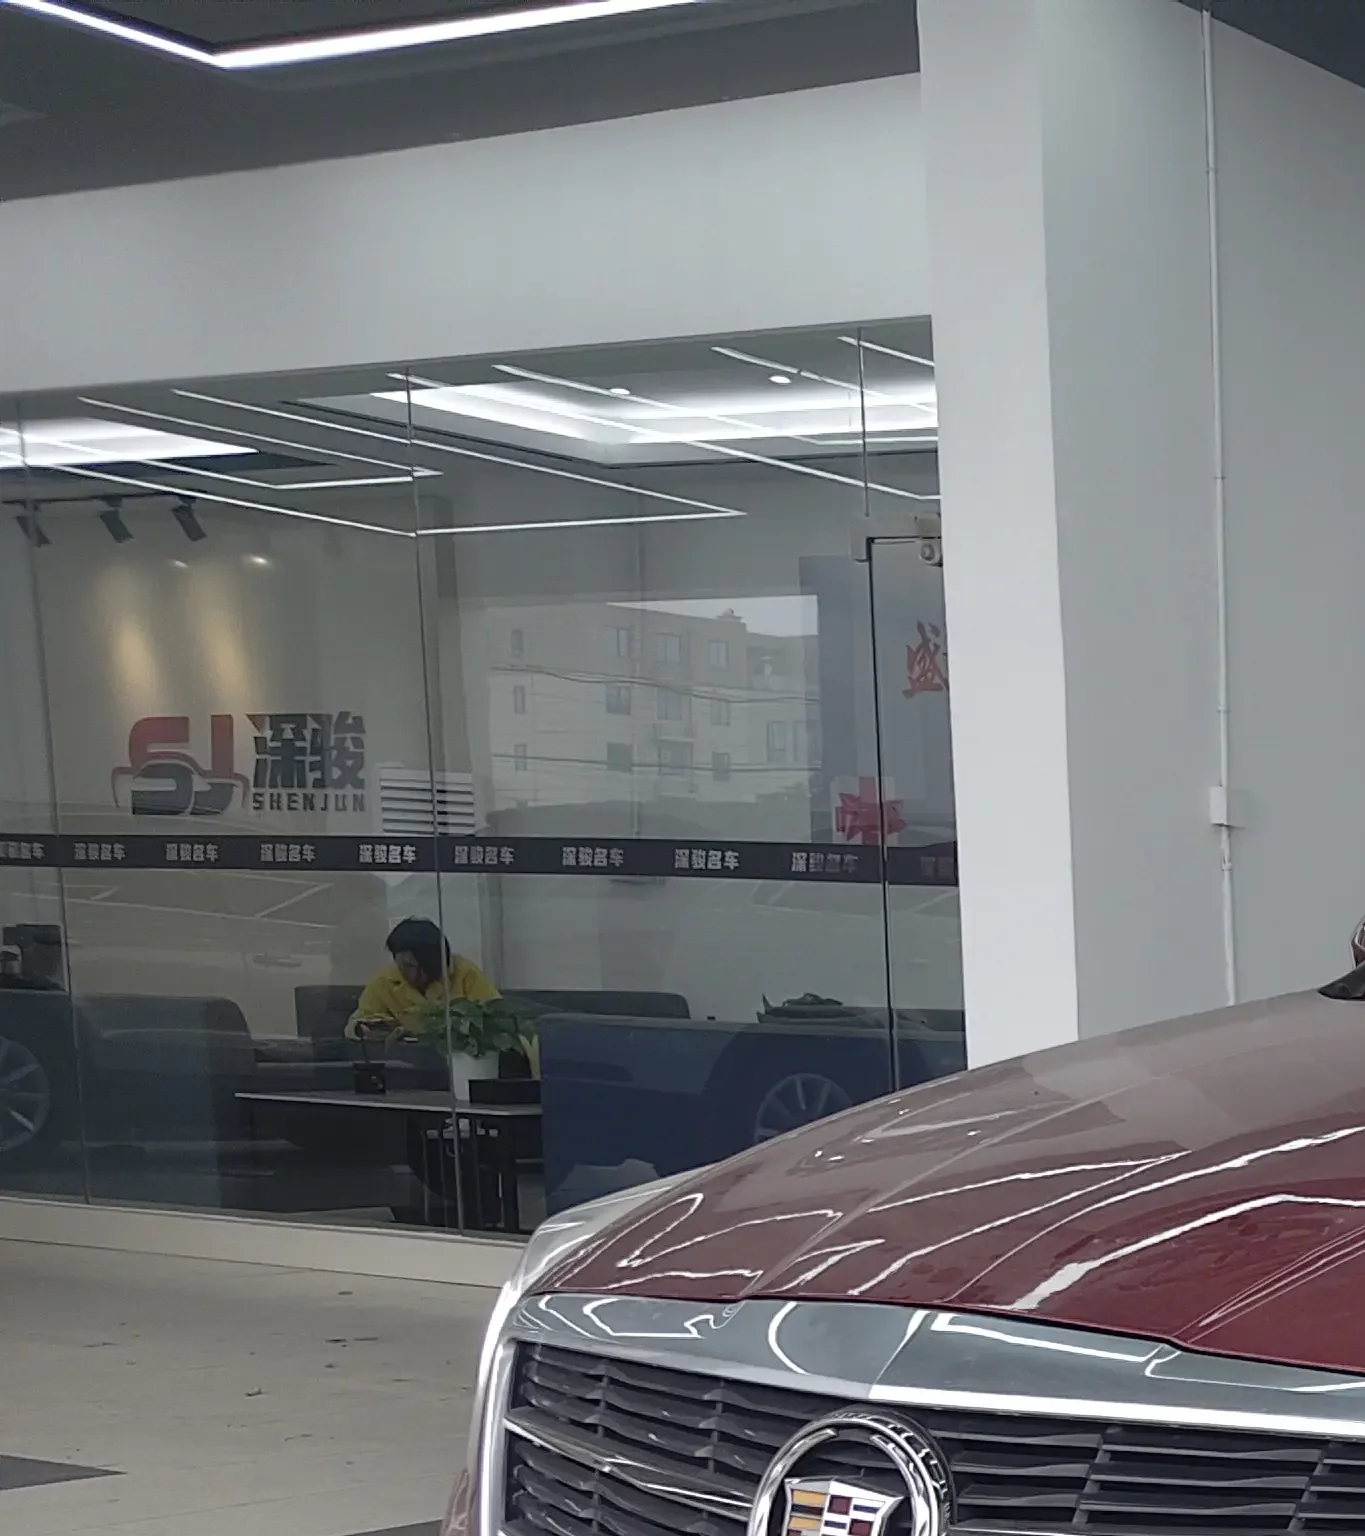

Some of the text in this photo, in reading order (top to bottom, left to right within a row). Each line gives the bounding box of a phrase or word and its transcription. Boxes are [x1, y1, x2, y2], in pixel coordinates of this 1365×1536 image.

[246, 711, 366, 790] 深骏
[252, 792, 366, 813] SHENJUN
[359, 844, 417, 864] 深骏名车
[674, 848, 740, 871] 深骏名车
